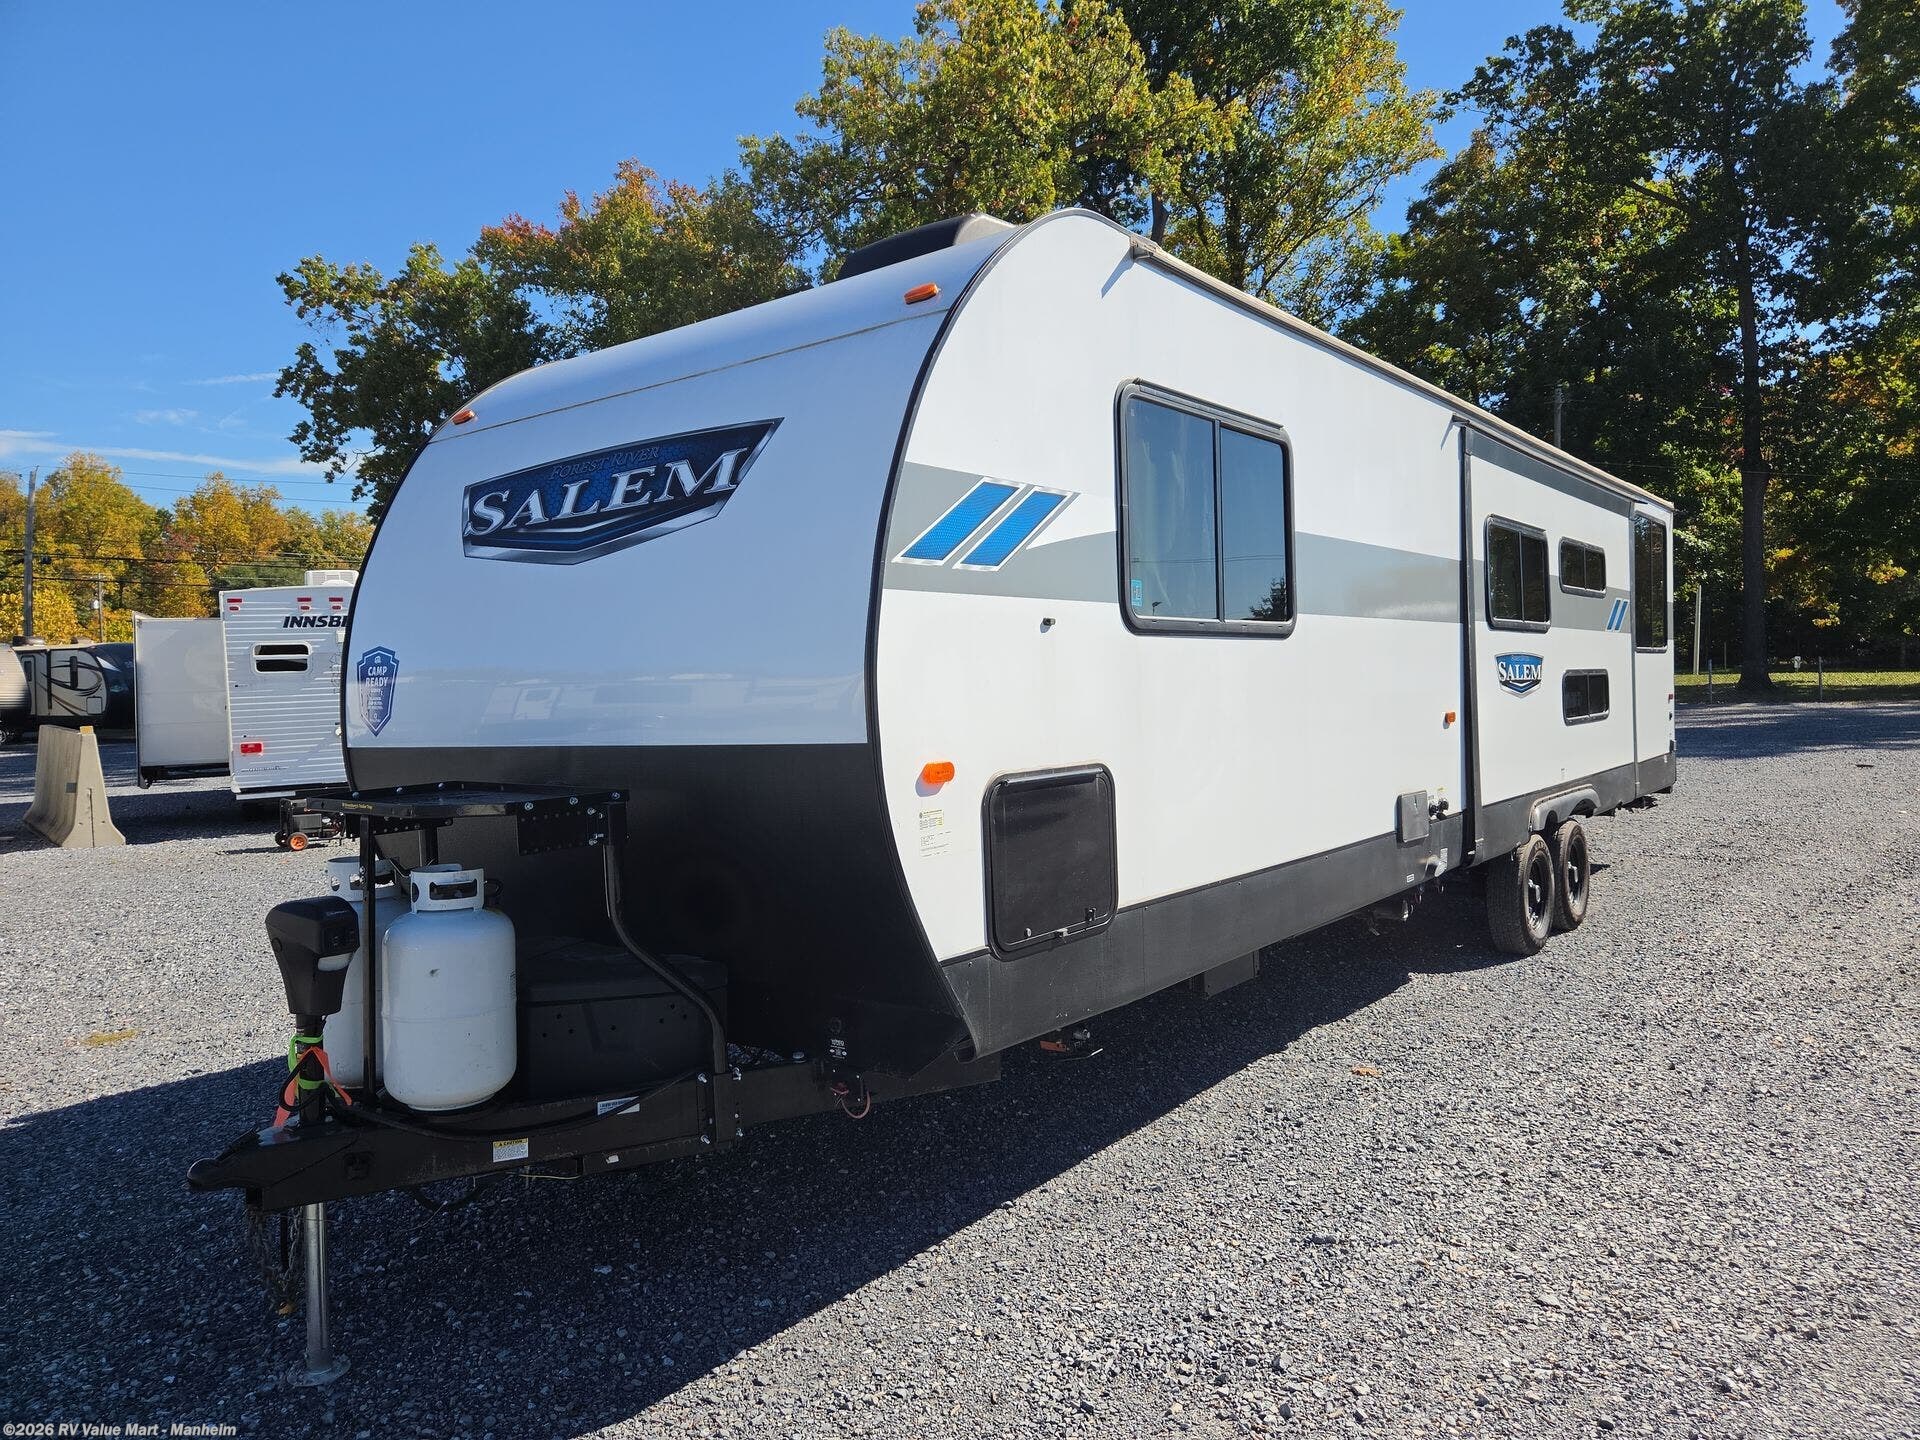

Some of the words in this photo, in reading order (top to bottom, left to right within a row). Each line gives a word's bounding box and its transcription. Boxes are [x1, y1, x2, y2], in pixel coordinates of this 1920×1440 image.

[548, 457, 610, 480] FOREST
[609, 446, 660, 468] RIVER
[464, 447, 749, 537] SALEM
[367, 666, 388, 677] CAMP
[1498, 661, 1542, 682] SALEM
[365, 677, 389, 688] READY
